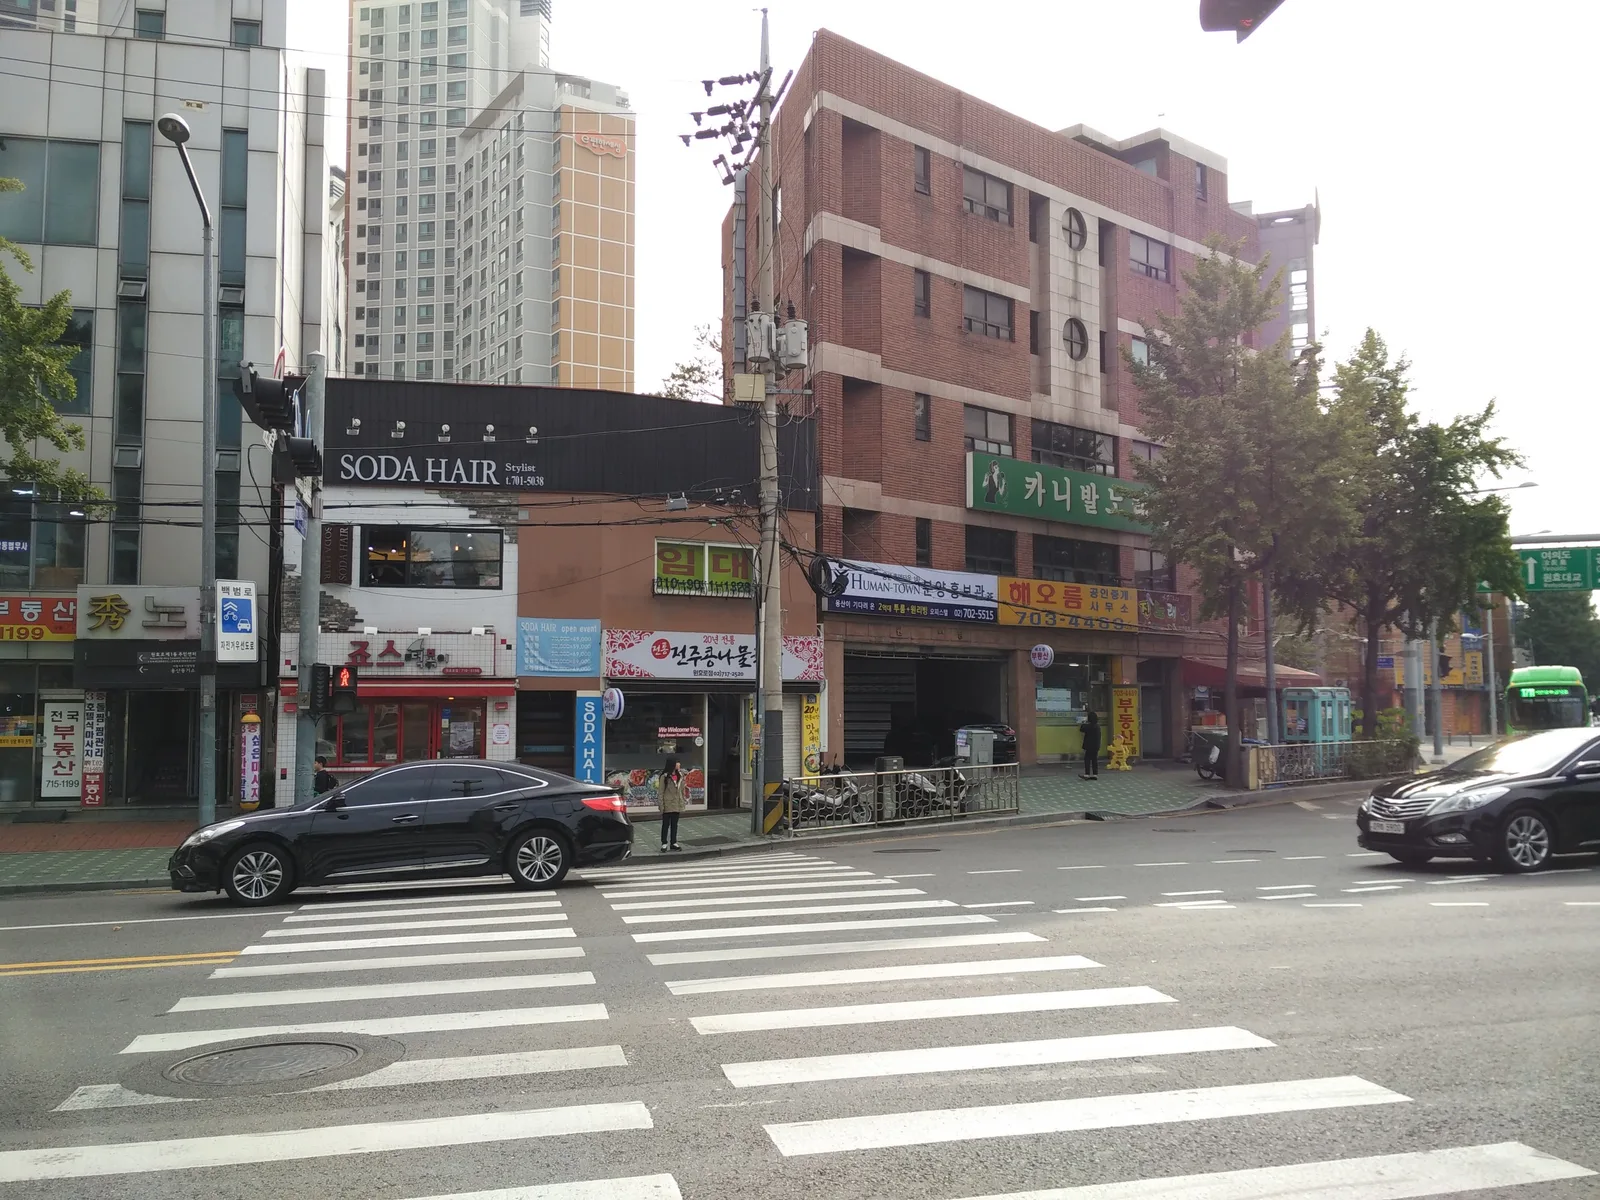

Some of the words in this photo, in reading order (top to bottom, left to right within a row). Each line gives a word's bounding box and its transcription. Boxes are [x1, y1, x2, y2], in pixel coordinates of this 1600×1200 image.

[341, 454, 420, 482] SODA
[425, 458, 500, 485] HAIR
[505, 463, 536, 473] Stylist
[340, 527, 349, 551] HAIR
[0, 541, 28, 551] 동법무사
[1541, 551, 1571, 559] 여의도
[657, 547, 749, 579] 임대
[221, 586, 252, 597] 백범로
[1009, 581, 1083, 609] 해오름
[1090, 587, 1129, 600] 공인중개
[86, 593, 131, 631] 秀
[1090, 601, 1129, 613] 사무소
[521, 622, 538, 632] SODA
[541, 624, 557, 632] HAIR
[561, 625, 577, 634] open
[580, 625, 597, 633] event
[221, 641, 255, 651] 자전거우선도로
[702, 635, 719, 645] 20년
[721, 635, 735, 645] 전통
[652, 641, 669, 656] 전통
[50, 711, 79, 722] 전국
[583, 701, 596, 743] SODA
[1117, 698, 1135, 746] 부동산
[52, 725, 75, 776] 부동산
[46, 780, 79, 788] 715-1199
[85, 775, 100, 804] 부동산
